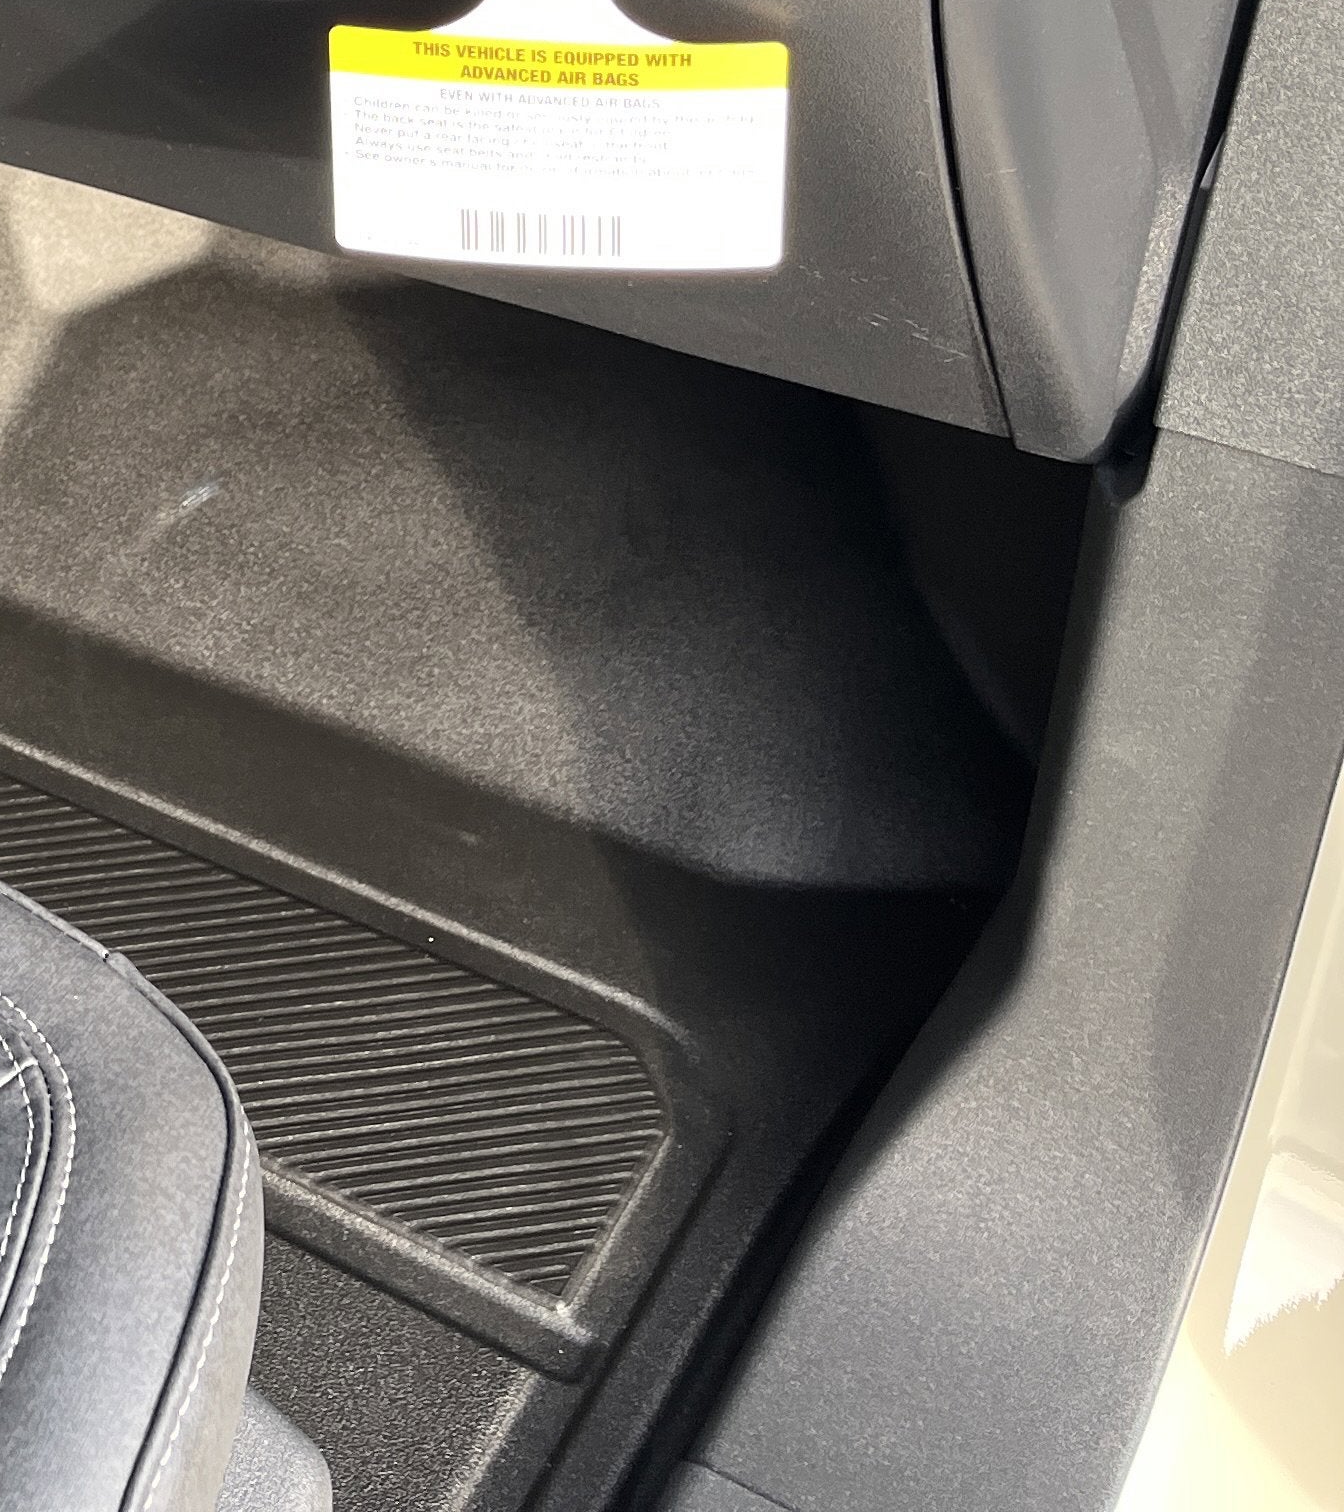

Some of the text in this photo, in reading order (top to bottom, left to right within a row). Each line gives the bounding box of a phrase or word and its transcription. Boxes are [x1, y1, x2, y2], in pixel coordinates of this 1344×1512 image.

[413, 41, 692, 67] THIS VEHICLE IS EQUIPPED WITH
[460, 65, 640, 87] ADVANCED AIR BAGS
[353, 96, 410, 110] Children
[440, 88, 473, 102] EVEN
[479, 92, 513, 103] WITH
[518, 94, 590, 108] ADVANCED
[594, 97, 618, 108] AIR
[354, 109, 379, 122] The
[383, 112, 414, 125] back
[354, 122, 393, 136] Never
[397, 128, 419, 141] put
[355, 136, 403, 151] Always
[355, 149, 380, 161] See
[384, 154, 437, 166] owners
